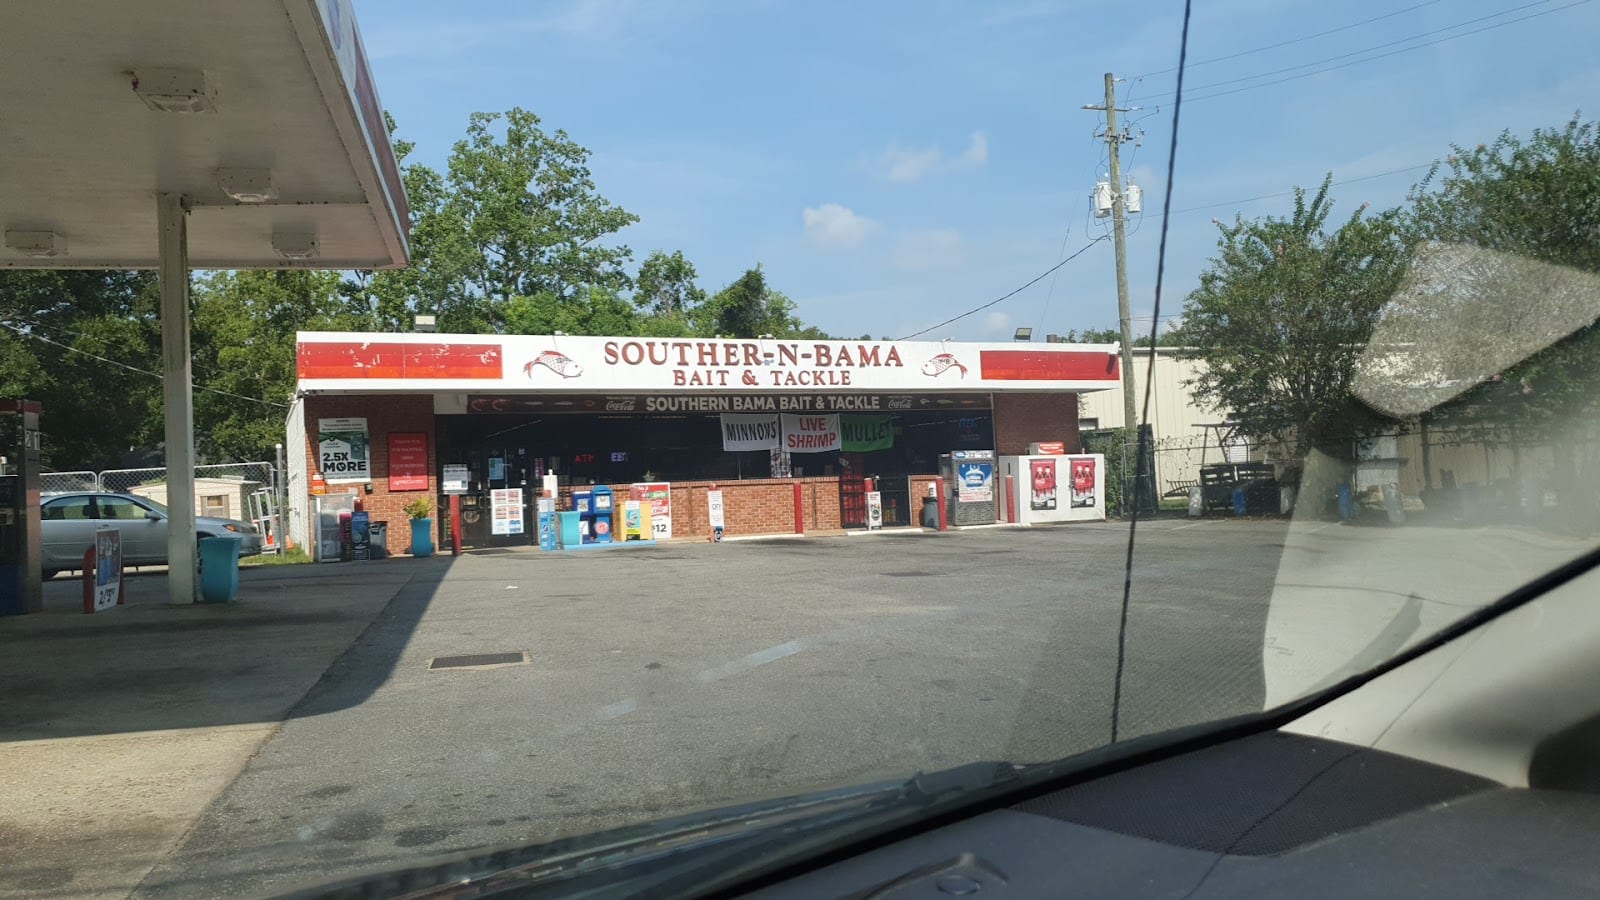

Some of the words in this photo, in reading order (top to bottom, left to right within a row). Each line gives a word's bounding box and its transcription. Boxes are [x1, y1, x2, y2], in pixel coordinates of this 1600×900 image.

[604, 341, 903, 368] SOUTHER-N-BAMA
[672, 369, 729, 386] BAIT
[741, 369, 760, 386] &
[770, 370, 852, 386] TACKLE
[646, 397, 730, 412] SOUTHERN
[733, 396, 776, 411] BAMA
[779, 396, 813, 410] BAIT
[815, 396, 826, 410] &
[827, 395, 881, 410] TACKLE
[800, 417, 827, 432] LIVE
[842, 421, 891, 443] MULLET
[787, 431, 837, 449] SHRIMP
[323, 452, 349, 462] 2.5X
[323, 461, 367, 473] MORE
